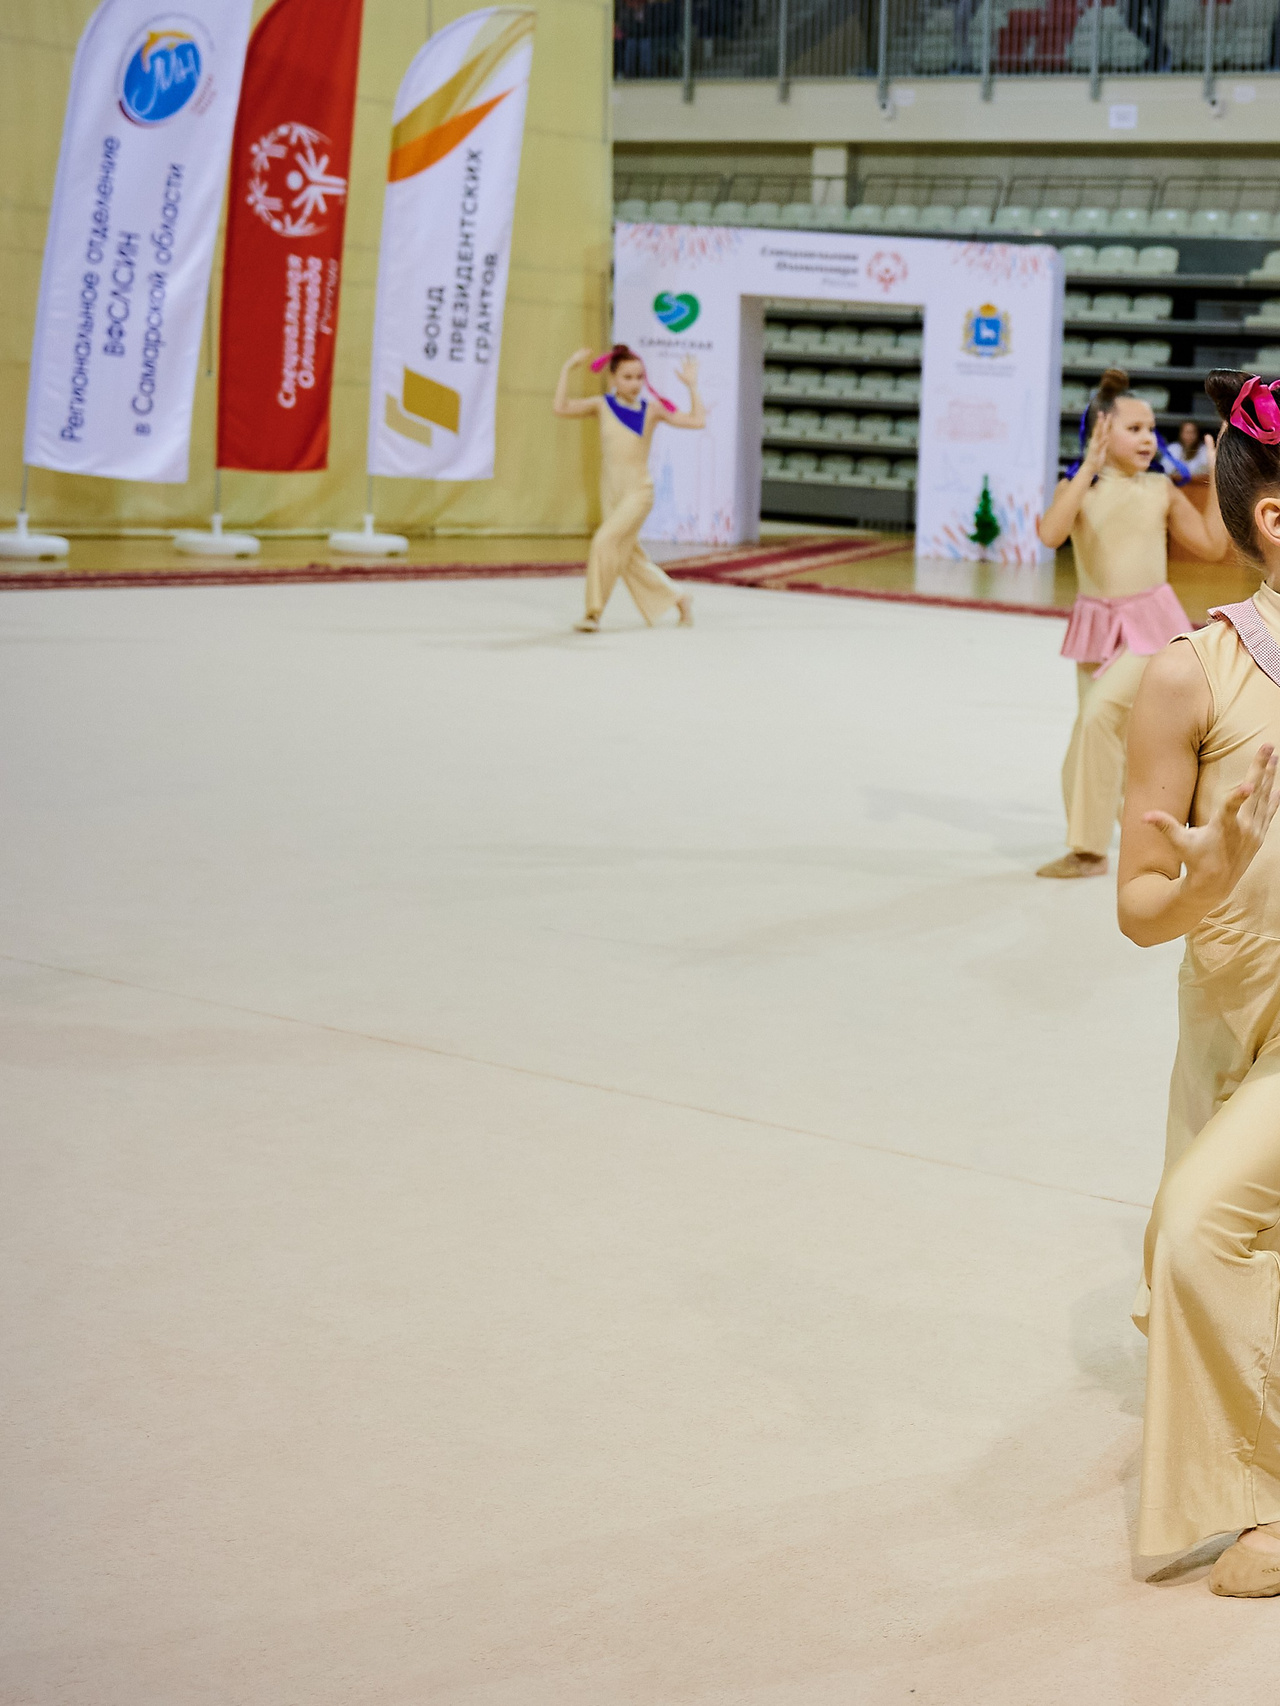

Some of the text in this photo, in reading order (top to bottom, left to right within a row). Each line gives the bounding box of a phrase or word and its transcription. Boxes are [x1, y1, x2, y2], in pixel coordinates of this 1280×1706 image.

[61, 136, 120, 443] Региональное отделение
[103, 231, 140, 357] ВФСЛСИН
[131, 164, 184, 437] в Самарской области
[423, 286, 445, 360] ФОНД
[449, 149, 482, 362] ПРЕЗИДЕНТСКИХ
[475, 253, 498, 364] ГРАНТОВ
